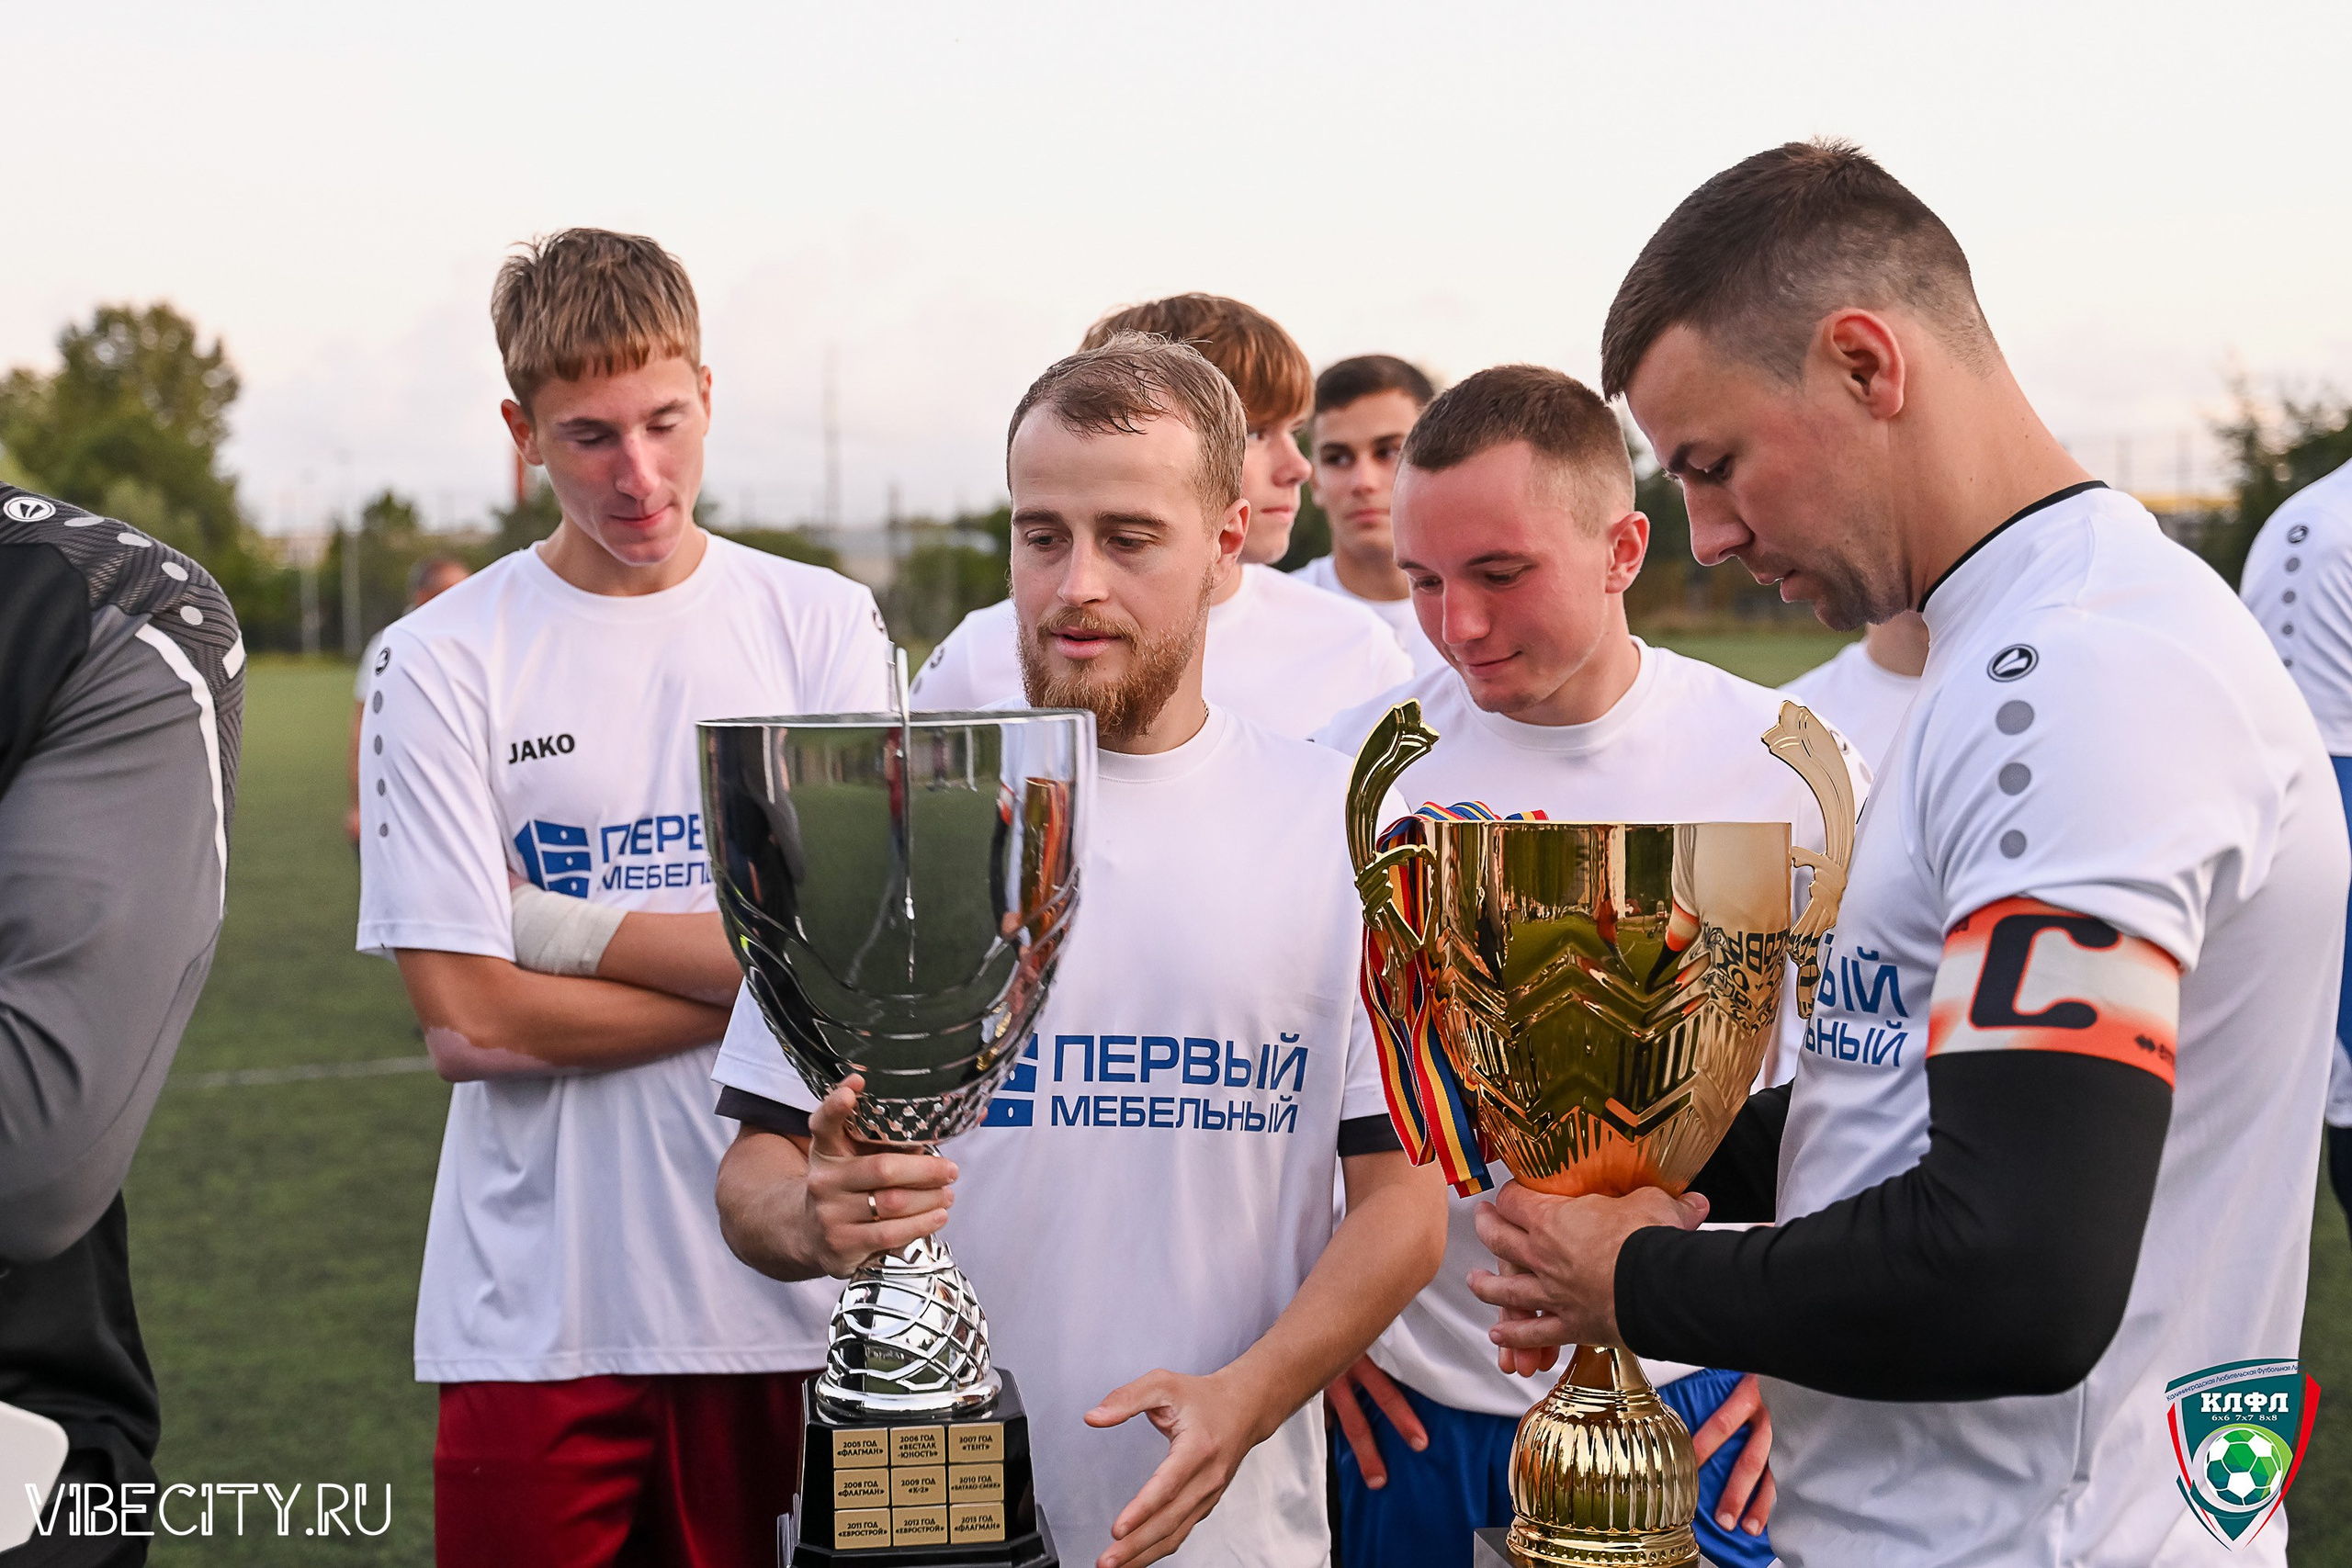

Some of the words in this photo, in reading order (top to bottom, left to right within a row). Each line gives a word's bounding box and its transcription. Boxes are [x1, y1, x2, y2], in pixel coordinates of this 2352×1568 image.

[509, 734, 574, 764] JAKO
[602, 862, 711, 889] МЕБЕЛ
[1970, 914, 2121, 1030] C
[1053, 1032, 1309, 1092] ПЕРВЫЙ
[1050, 1094, 1299, 1134] МЕБЕЛЬНЫЙ
[862, 1439, 878, 1448] ГОД
[900, 1435, 919, 1443] 2006
[922, 1477, 936, 1485] ГОД
[903, 1518, 920, 1527] 2012
